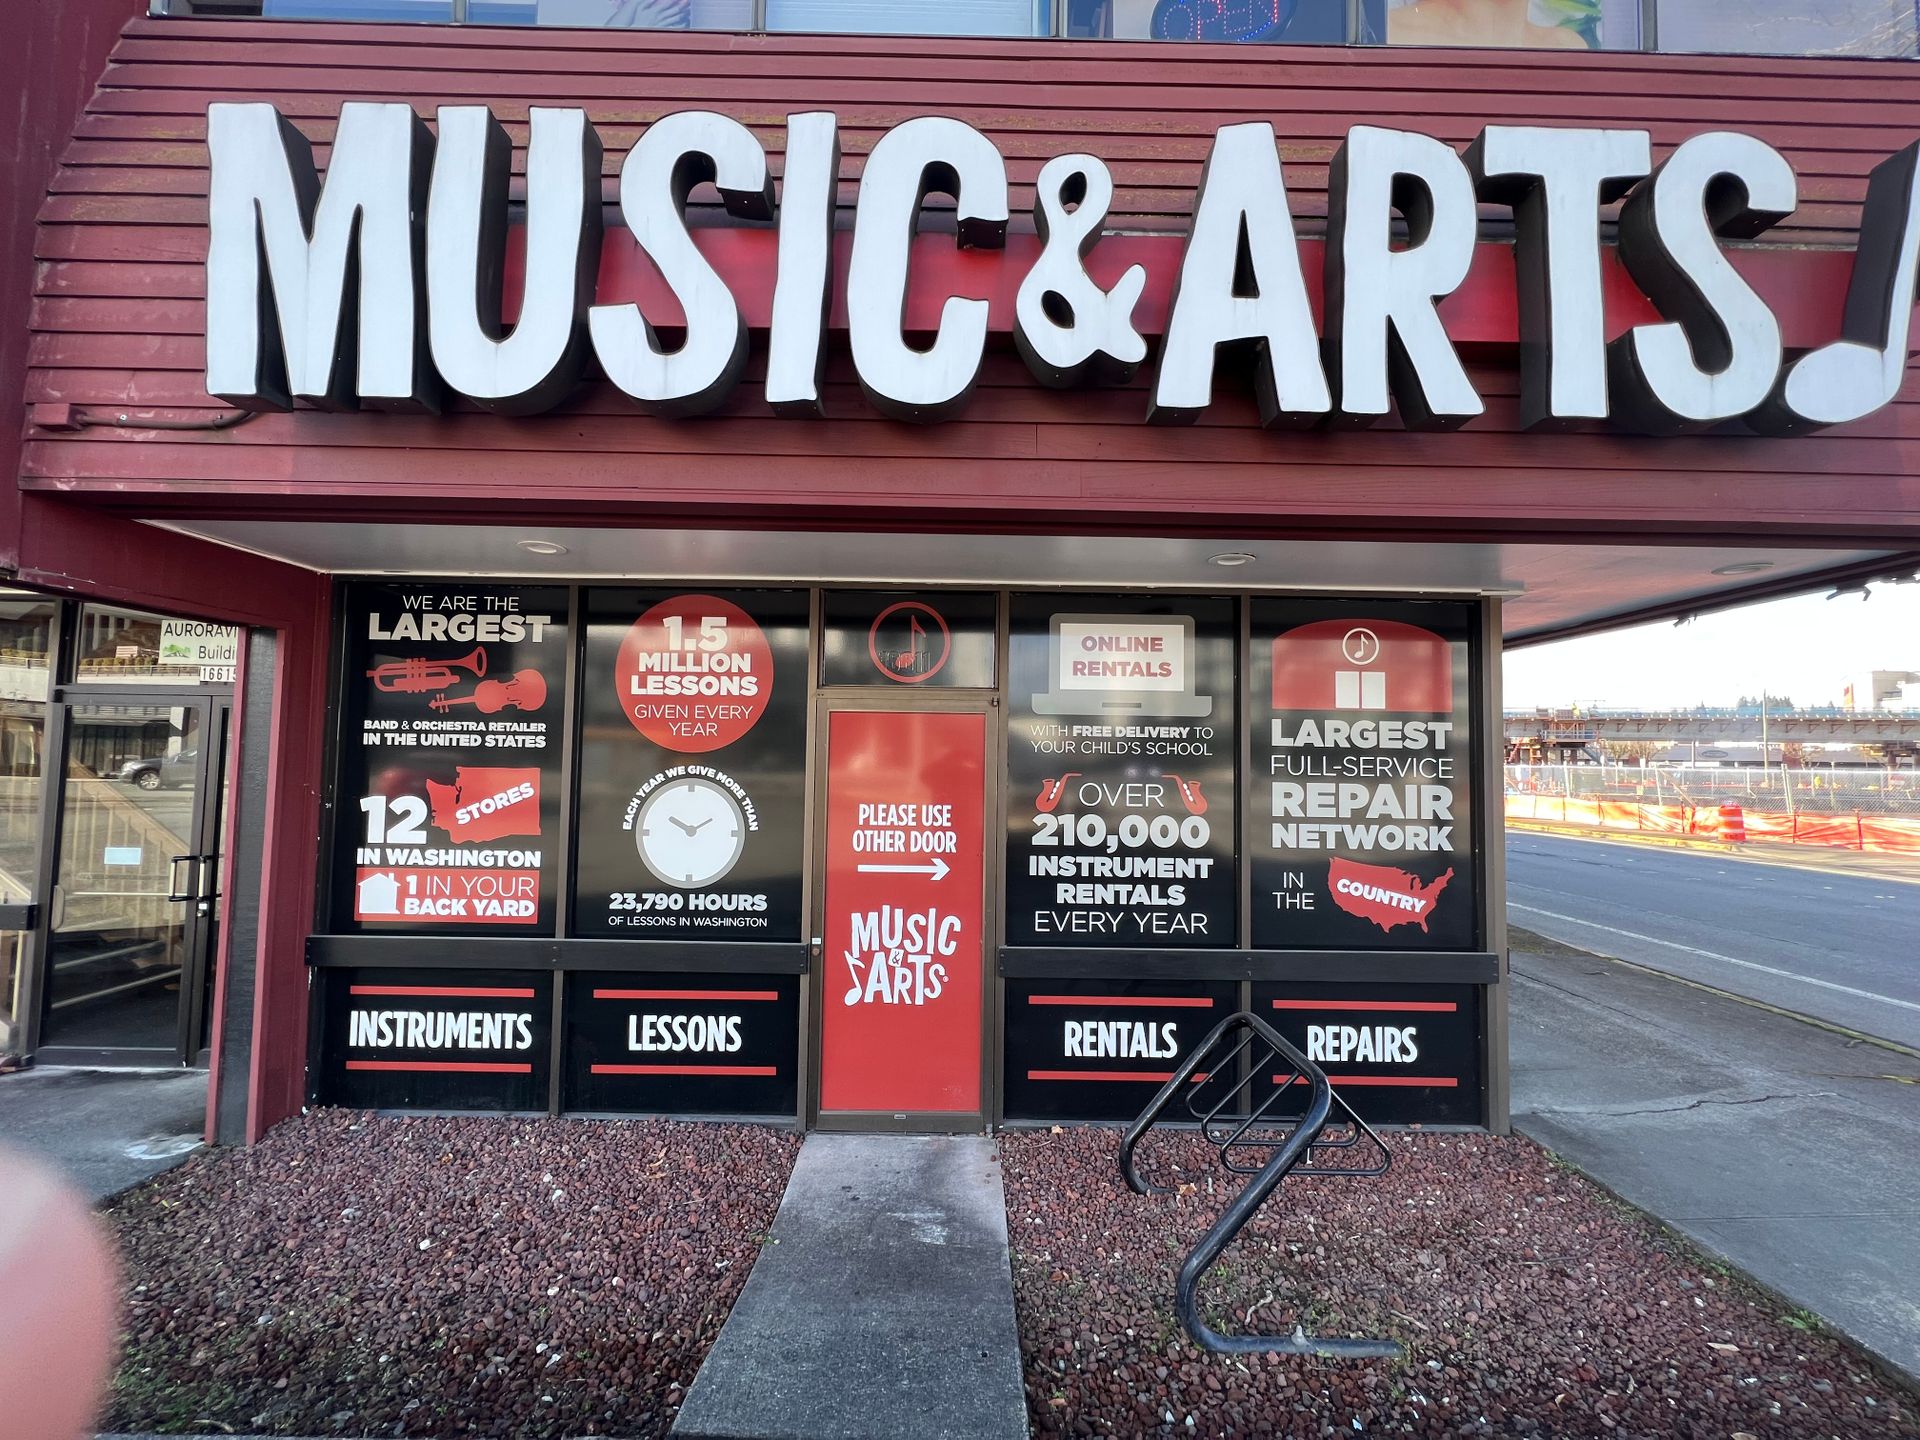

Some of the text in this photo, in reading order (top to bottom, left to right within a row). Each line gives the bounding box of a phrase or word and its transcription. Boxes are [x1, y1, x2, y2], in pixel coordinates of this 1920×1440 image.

[205, 102, 1798, 422] MUSIC & ARTS
[403, 595, 519, 611] WE ARE THE
[369, 613, 551, 643] LARGEST
[662, 615, 728, 652] 1.5
[1081, 636, 1163, 653] ONLINE
[639, 652, 751, 673] MILLION
[1073, 660, 1173, 678] RENTALS
[630, 675, 758, 696] LESSONS
[634, 704, 753, 720] GIVEN EVERY
[364, 720, 546, 733] BAND & ORCHESTRA RETAILER
[669, 722, 718, 737] YEAR
[1030, 725, 1214, 739] WITH FREE DELIVERY TO
[1271, 718, 1453, 750] LARGEST
[363, 733, 546, 748] IN THE UNITED STATES
[1031, 741, 1213, 756] YOUR CHILD'S SCHOOL
[1271, 755, 1454, 779] FULL-SERVICE
[622, 765, 759, 832] EACH YEAR WE GIVE MORE THAN
[1079, 782, 1164, 808] OVER
[1271, 781, 1454, 820] REPAIR
[360, 782, 535, 845] 12 STORES
[858, 803, 952, 827] PLEASE USE
[852, 829, 957, 853] OTHER DOOR
[1031, 813, 1211, 854] 210,000
[1271, 823, 1454, 851] NETWORK
[356, 848, 541, 868] IN WASHINGTON
[1029, 855, 1214, 879] INSTRUMENT
[406, 875, 534, 897] 1 IN YOUR
[1283, 871, 1304, 889] IN
[609, 893, 768, 913] 23,790 HOURS
[1056, 883, 1186, 906] RENTALS
[1272, 892, 1315, 910] THE
[1336, 878, 1427, 913] COUNTRY
[404, 898, 535, 917] BACK YARD
[608, 916, 768, 928] OF LESSONS IN WASHINGTON
[851, 905, 961, 958] MUSIC
[1034, 911, 1208, 935] EVERY YEAR
[349, 1010, 533, 1051] INSTRUMENTS
[628, 1014, 742, 1052] LESSONS
[1064, 1021, 1178, 1058] RENTALS
[1307, 1025, 1418, 1062] REPAIRS
